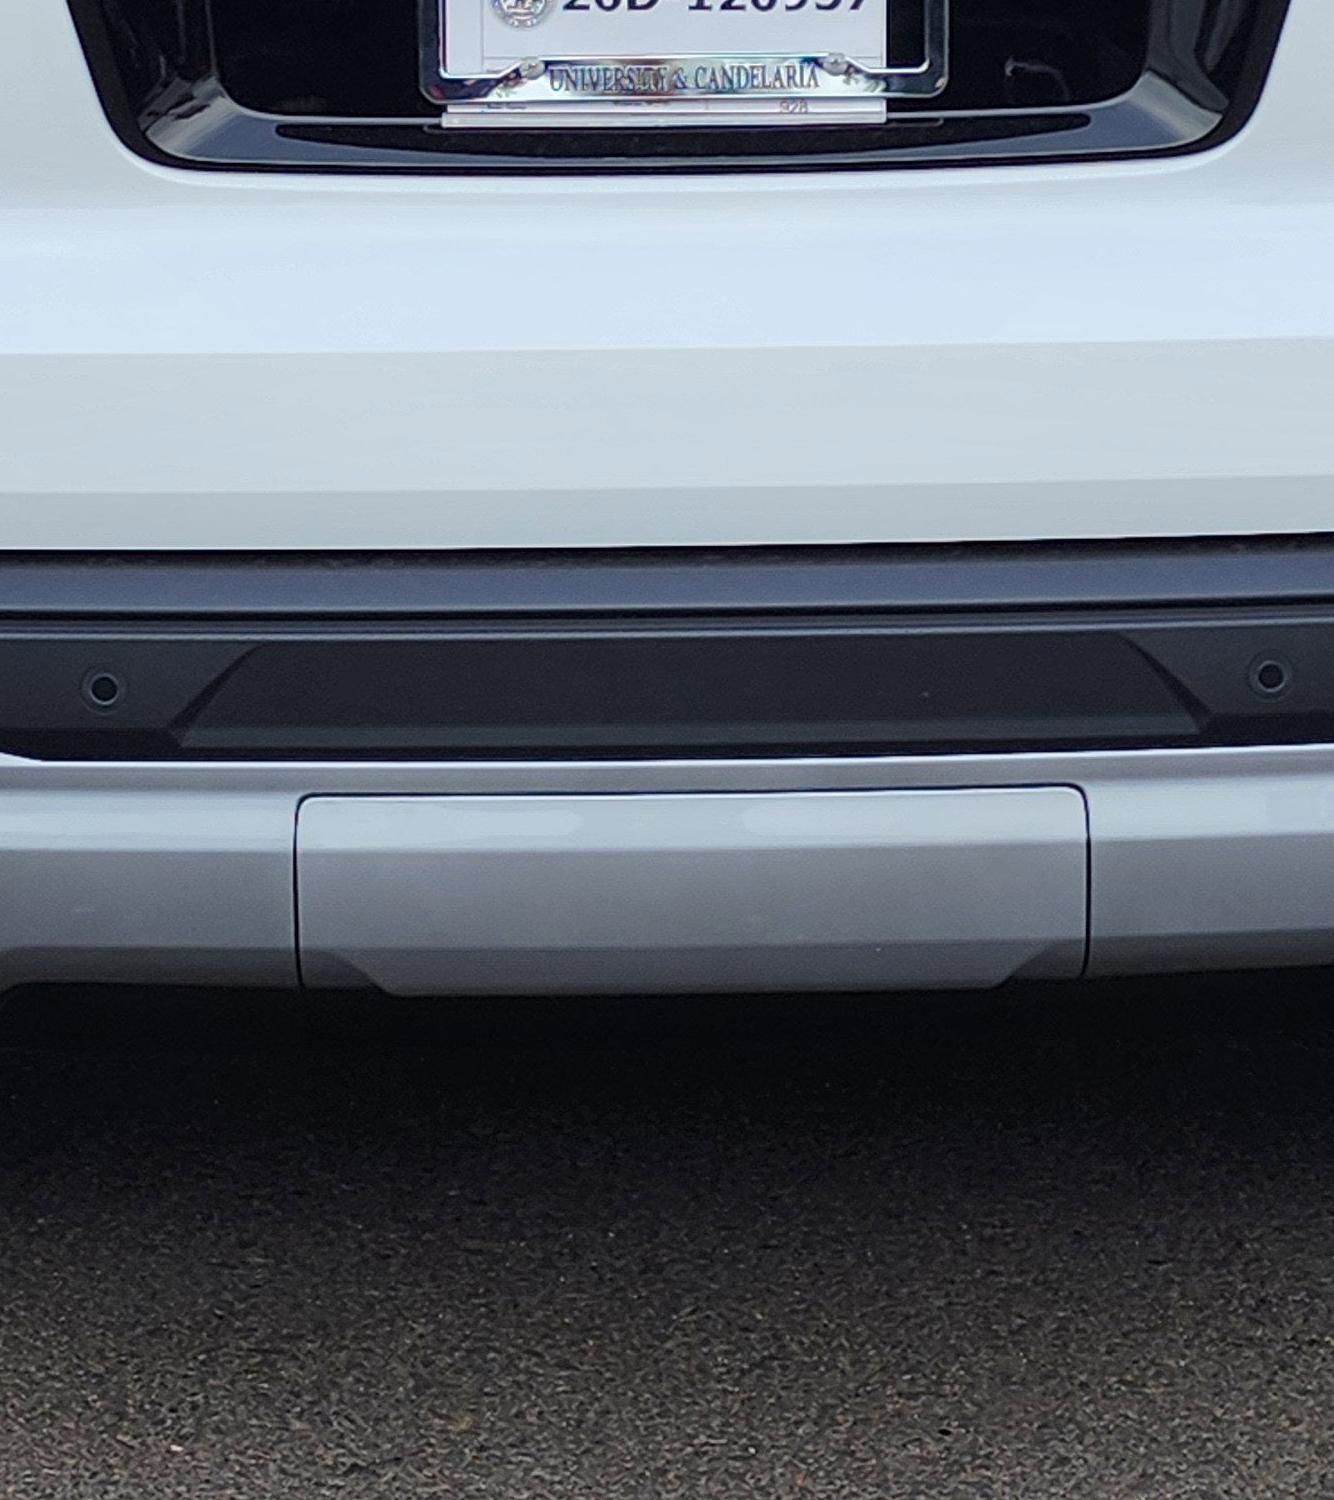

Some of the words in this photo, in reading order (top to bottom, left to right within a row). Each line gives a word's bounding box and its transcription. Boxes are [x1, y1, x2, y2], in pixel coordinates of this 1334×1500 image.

[549, 66, 668, 92] UNIVERSITY
[673, 67, 688, 90] &
[694, 63, 819, 90] CANDELARIA
